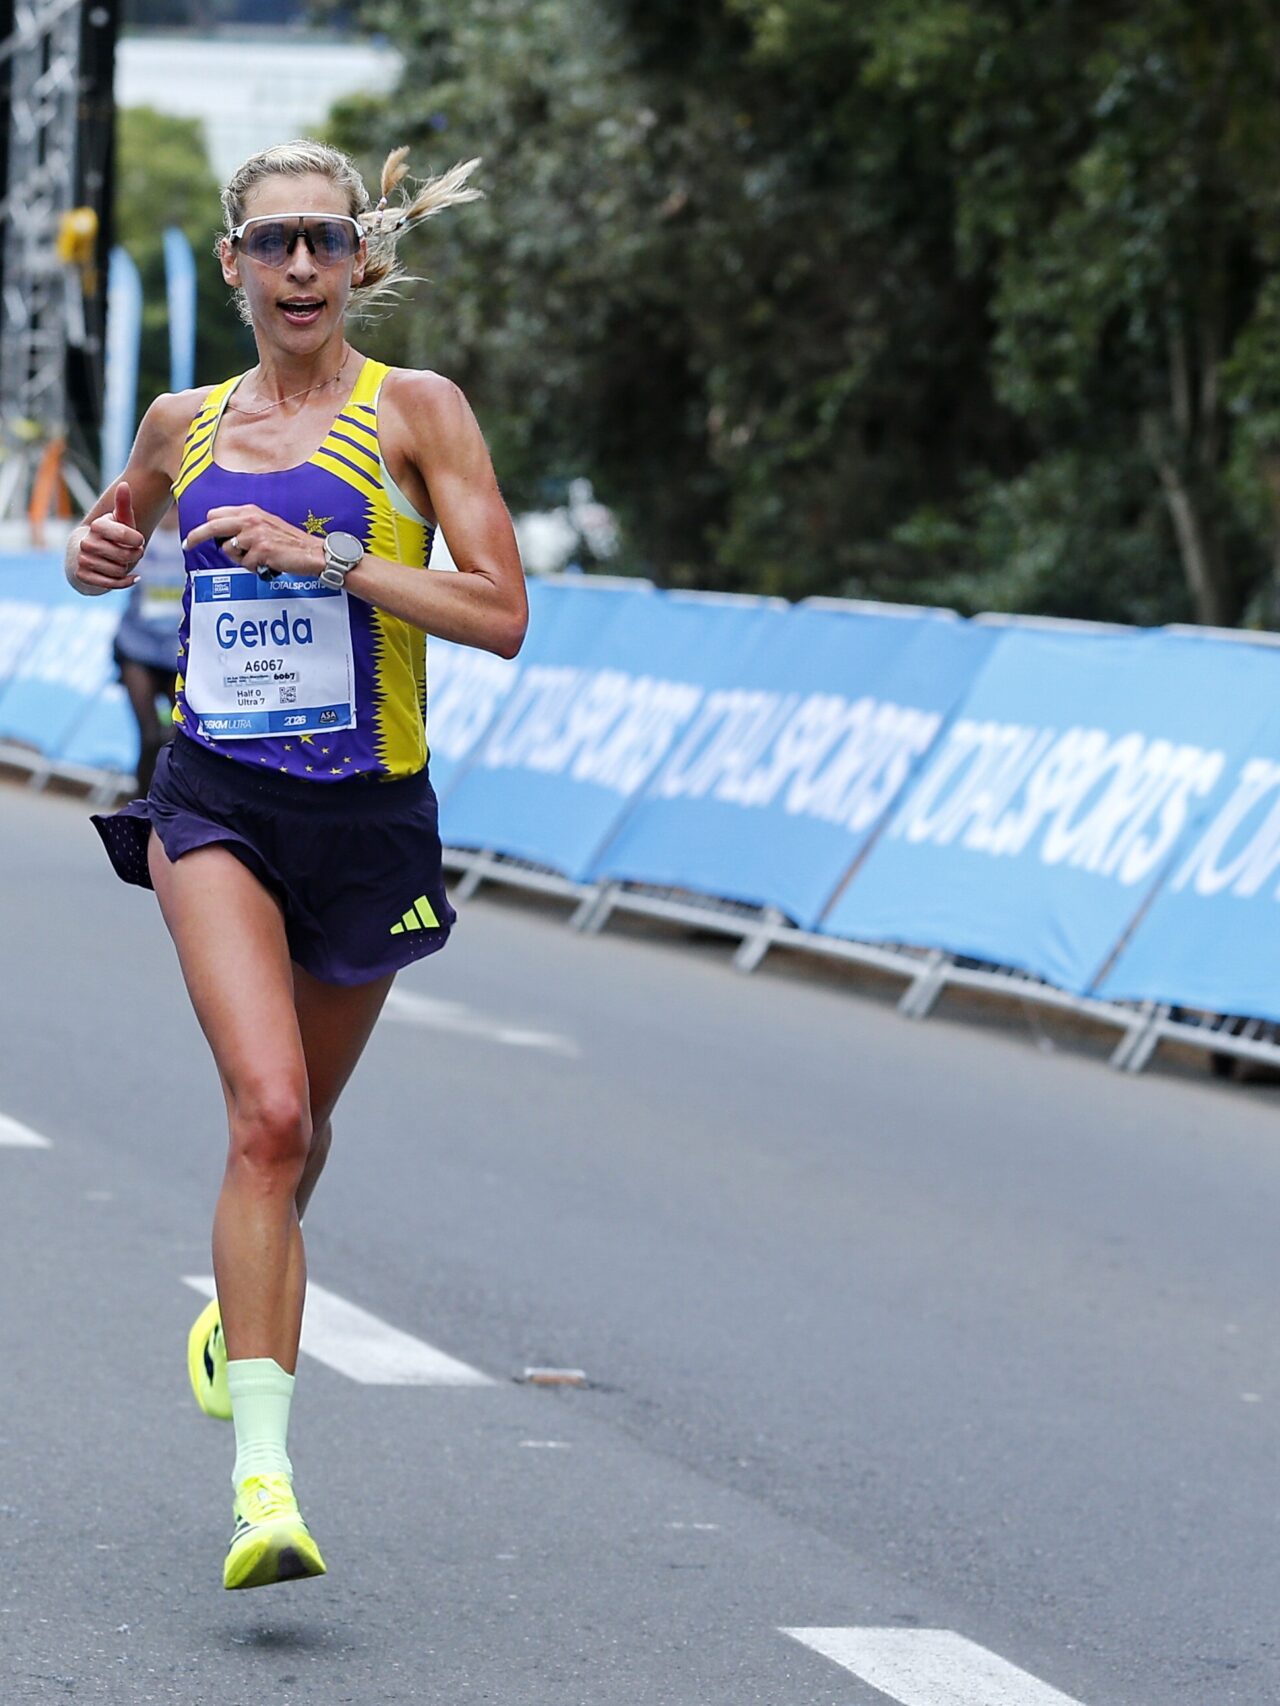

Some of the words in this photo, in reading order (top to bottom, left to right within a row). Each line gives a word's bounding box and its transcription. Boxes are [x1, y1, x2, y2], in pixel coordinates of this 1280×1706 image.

[216, 609, 313, 650] Gerda
[244, 659, 284, 673] A6067
[273, 672, 296, 681] 6067
[237, 689, 254, 698] Half
[237, 698, 258, 706] Ultra
[259, 697, 265, 705] 7
[320, 711, 336, 720] ASA
[228, 719, 252, 730] ULTRA
[283, 715, 307, 727] 2026
